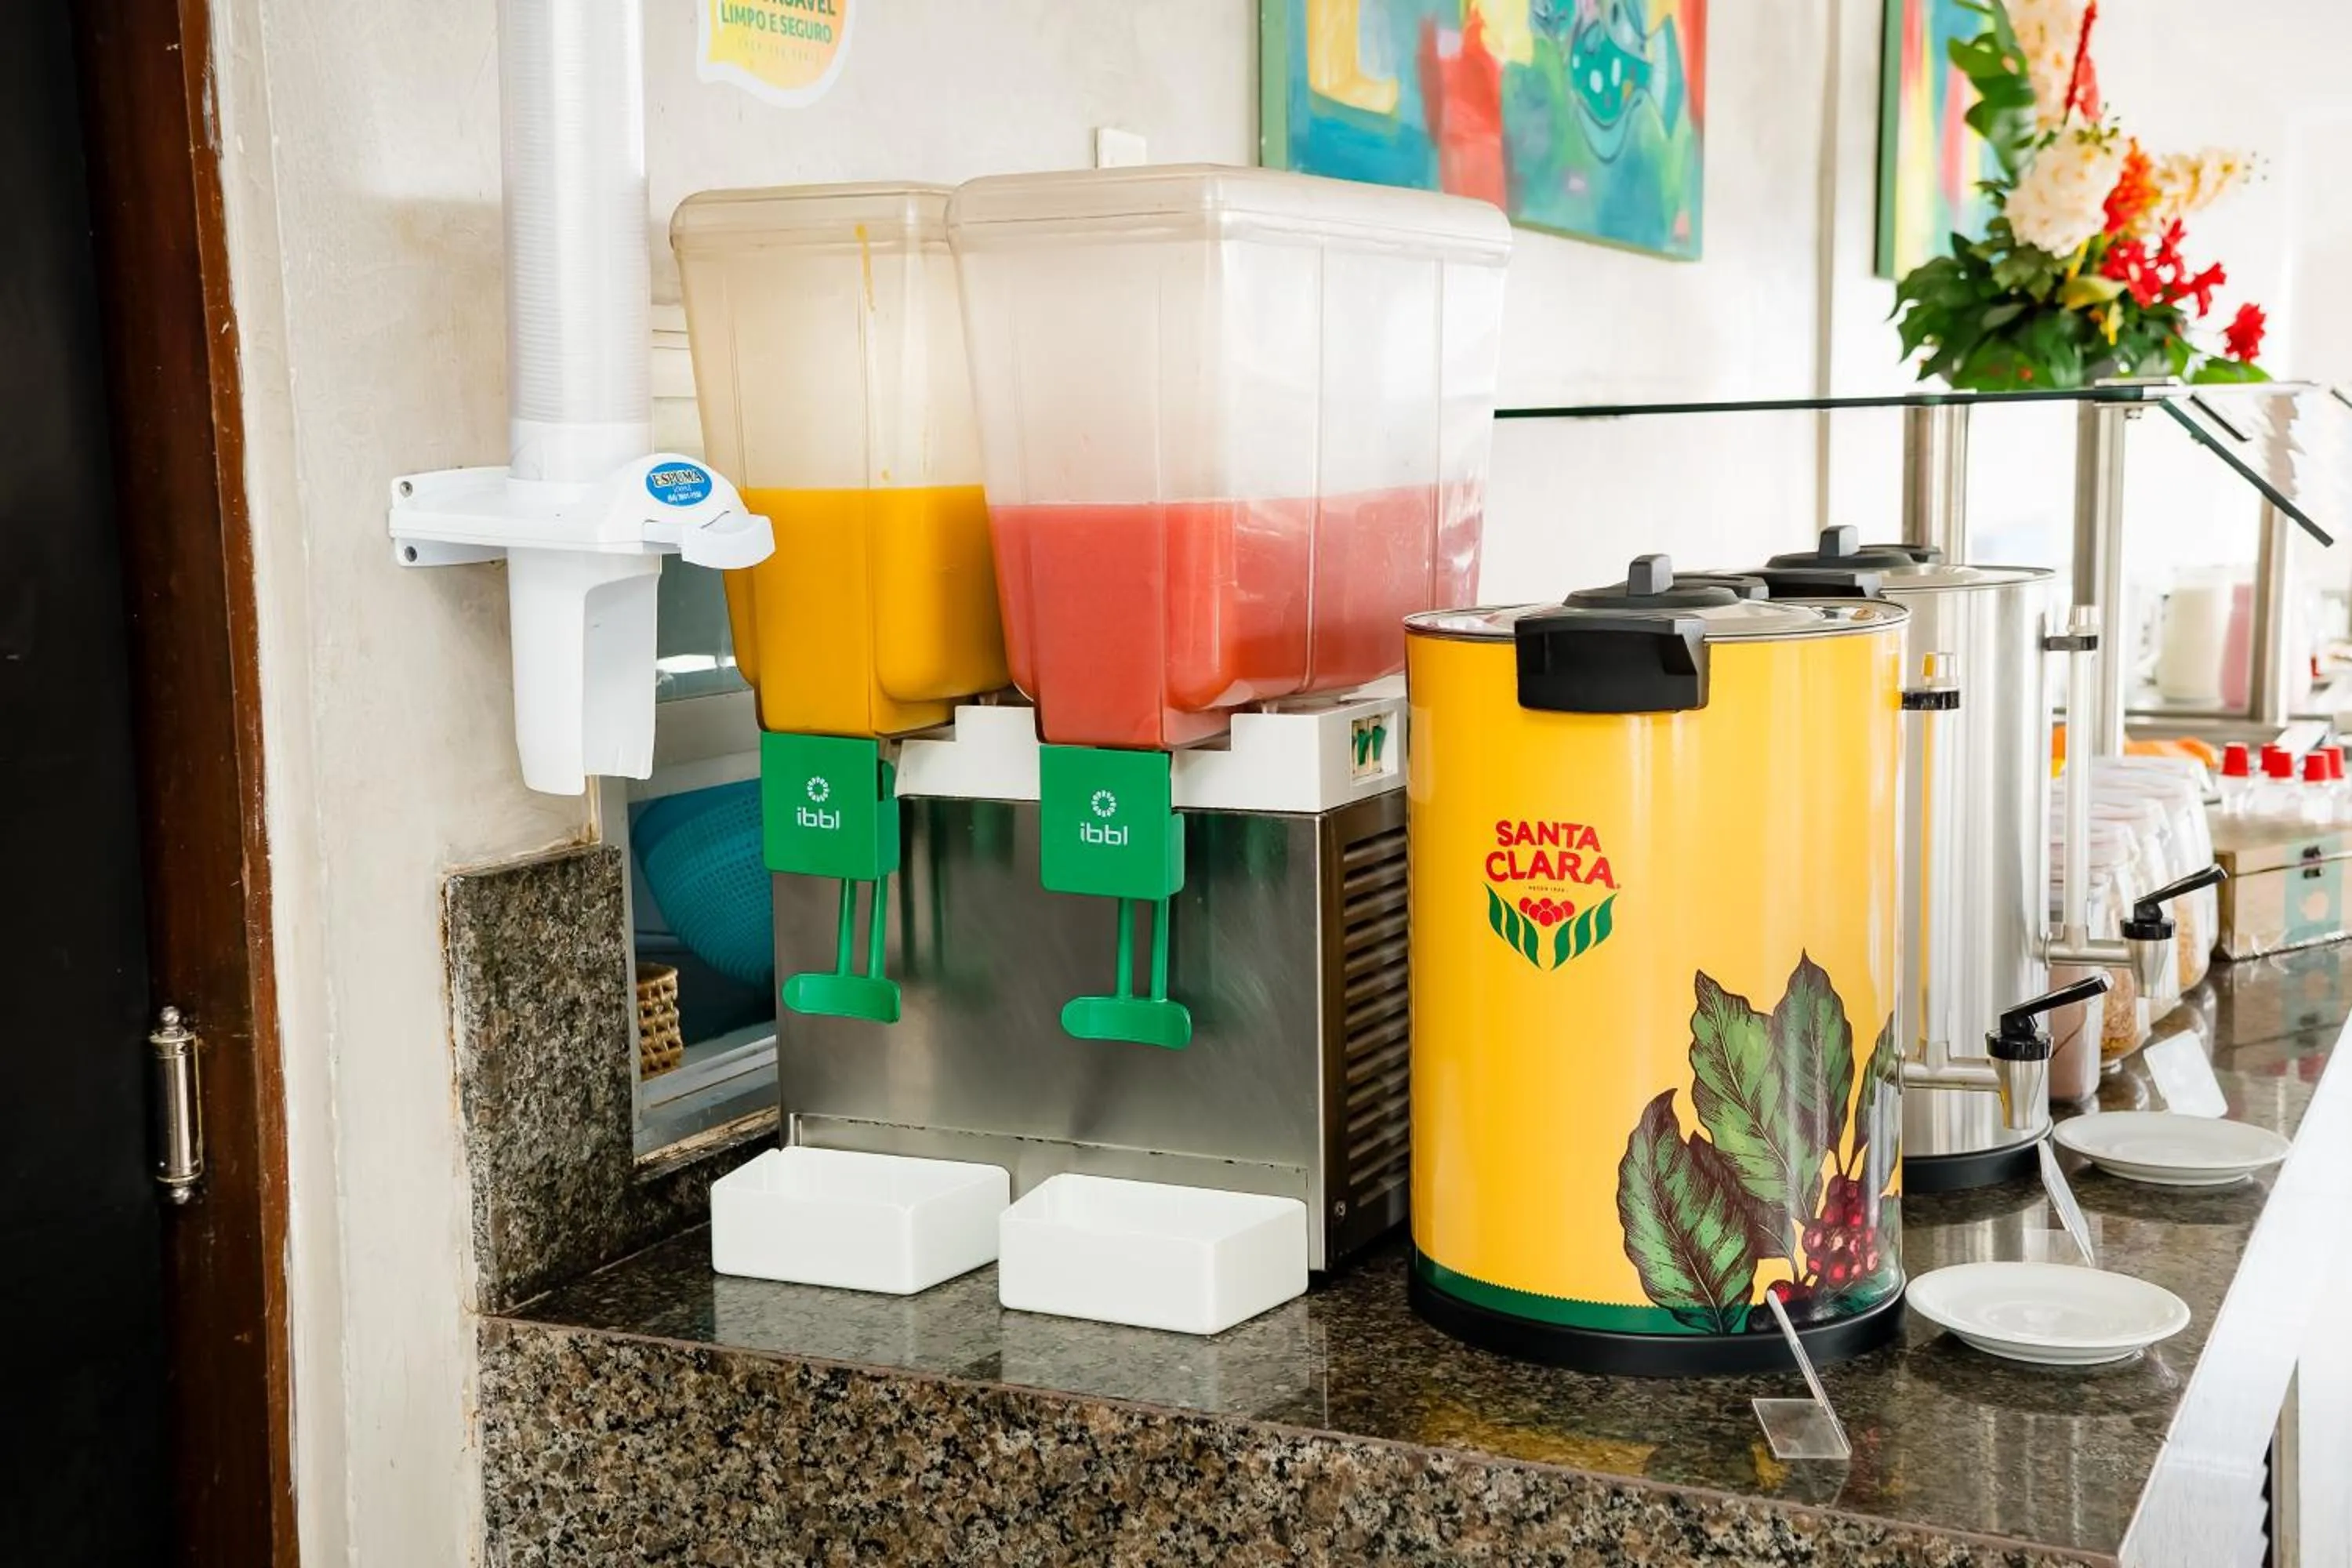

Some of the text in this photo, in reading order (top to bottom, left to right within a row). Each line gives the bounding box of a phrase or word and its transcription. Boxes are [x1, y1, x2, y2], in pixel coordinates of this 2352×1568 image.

[721, 3, 766, 31] LIMPO
[770, 13, 779, 32] E
[780, 15, 832, 44] SEGURO
[797, 806, 840, 829] ibbl
[1080, 822, 1127, 846] ibbl
[1495, 820, 1601, 852] SANTA
[1486, 850, 1616, 889] CLARA
